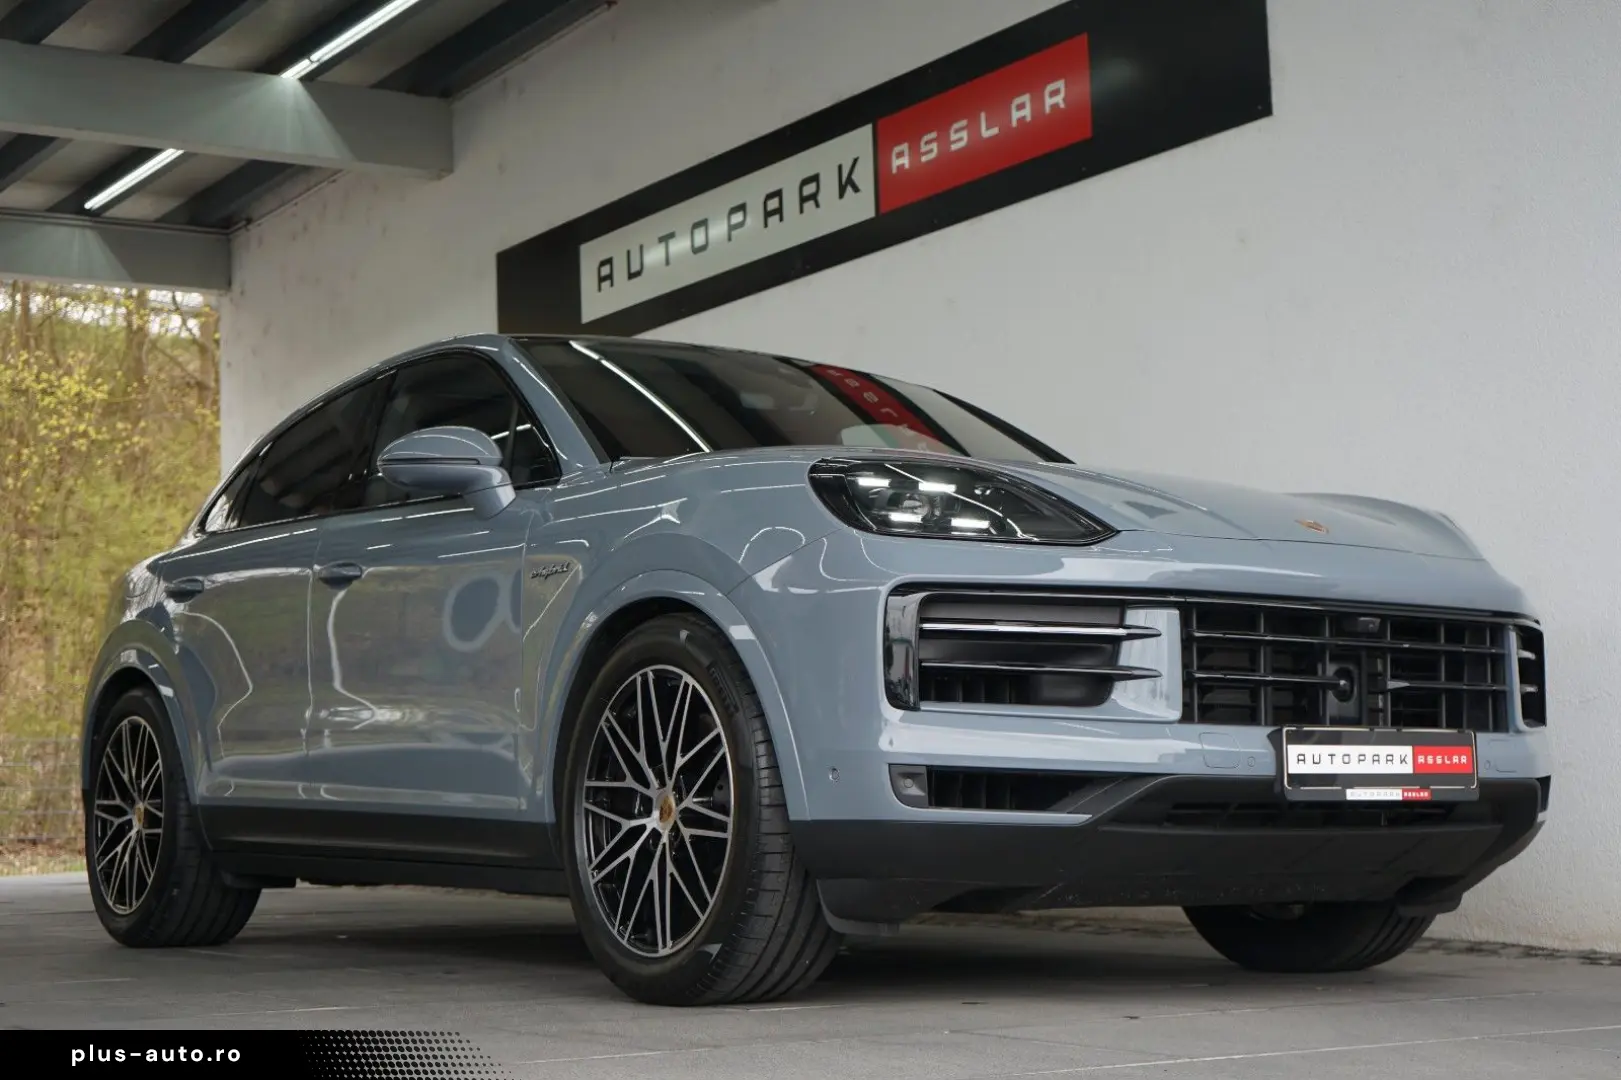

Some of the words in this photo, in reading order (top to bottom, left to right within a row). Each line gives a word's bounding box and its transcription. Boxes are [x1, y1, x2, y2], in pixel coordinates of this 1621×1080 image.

[596, 156, 862, 293] AUTOPARK
[891, 78, 1067, 175] ASSLAR
[1296, 753, 1409, 765] AUTOPARK
[1417, 754, 1468, 765] ASSLAR
